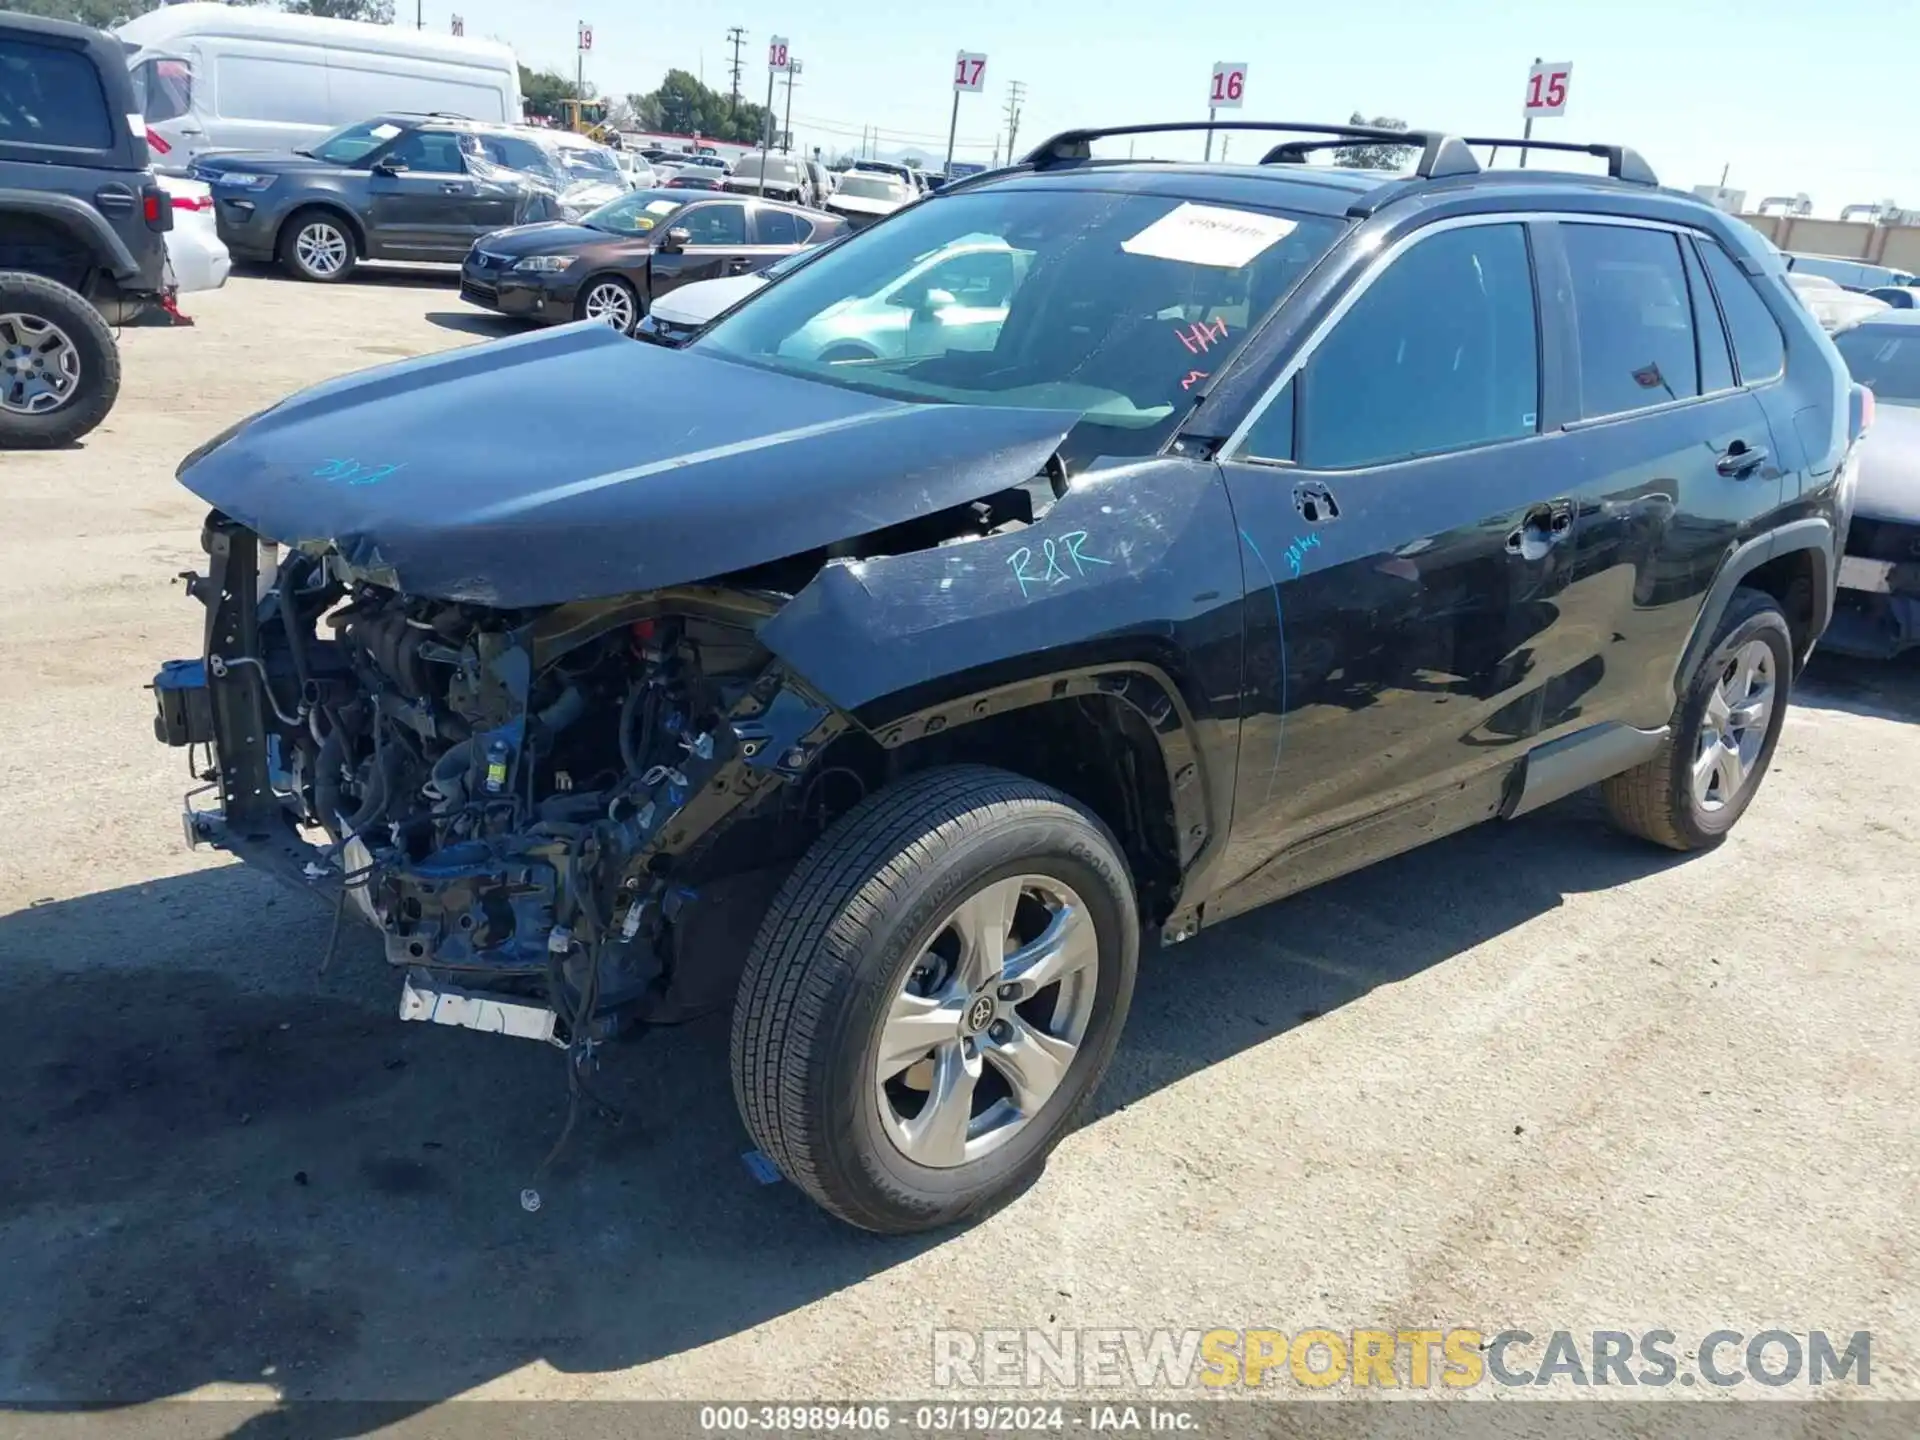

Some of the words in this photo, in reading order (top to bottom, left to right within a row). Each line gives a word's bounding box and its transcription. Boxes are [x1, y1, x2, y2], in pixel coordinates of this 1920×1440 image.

[578, 30, 592, 50] 19
[769, 44, 788, 66] 18
[955, 60, 985, 86] 17
[1211, 71, 1243, 100] 16
[1525, 72, 1568, 108] 15
[1006, 530, 1112, 597] R&R
